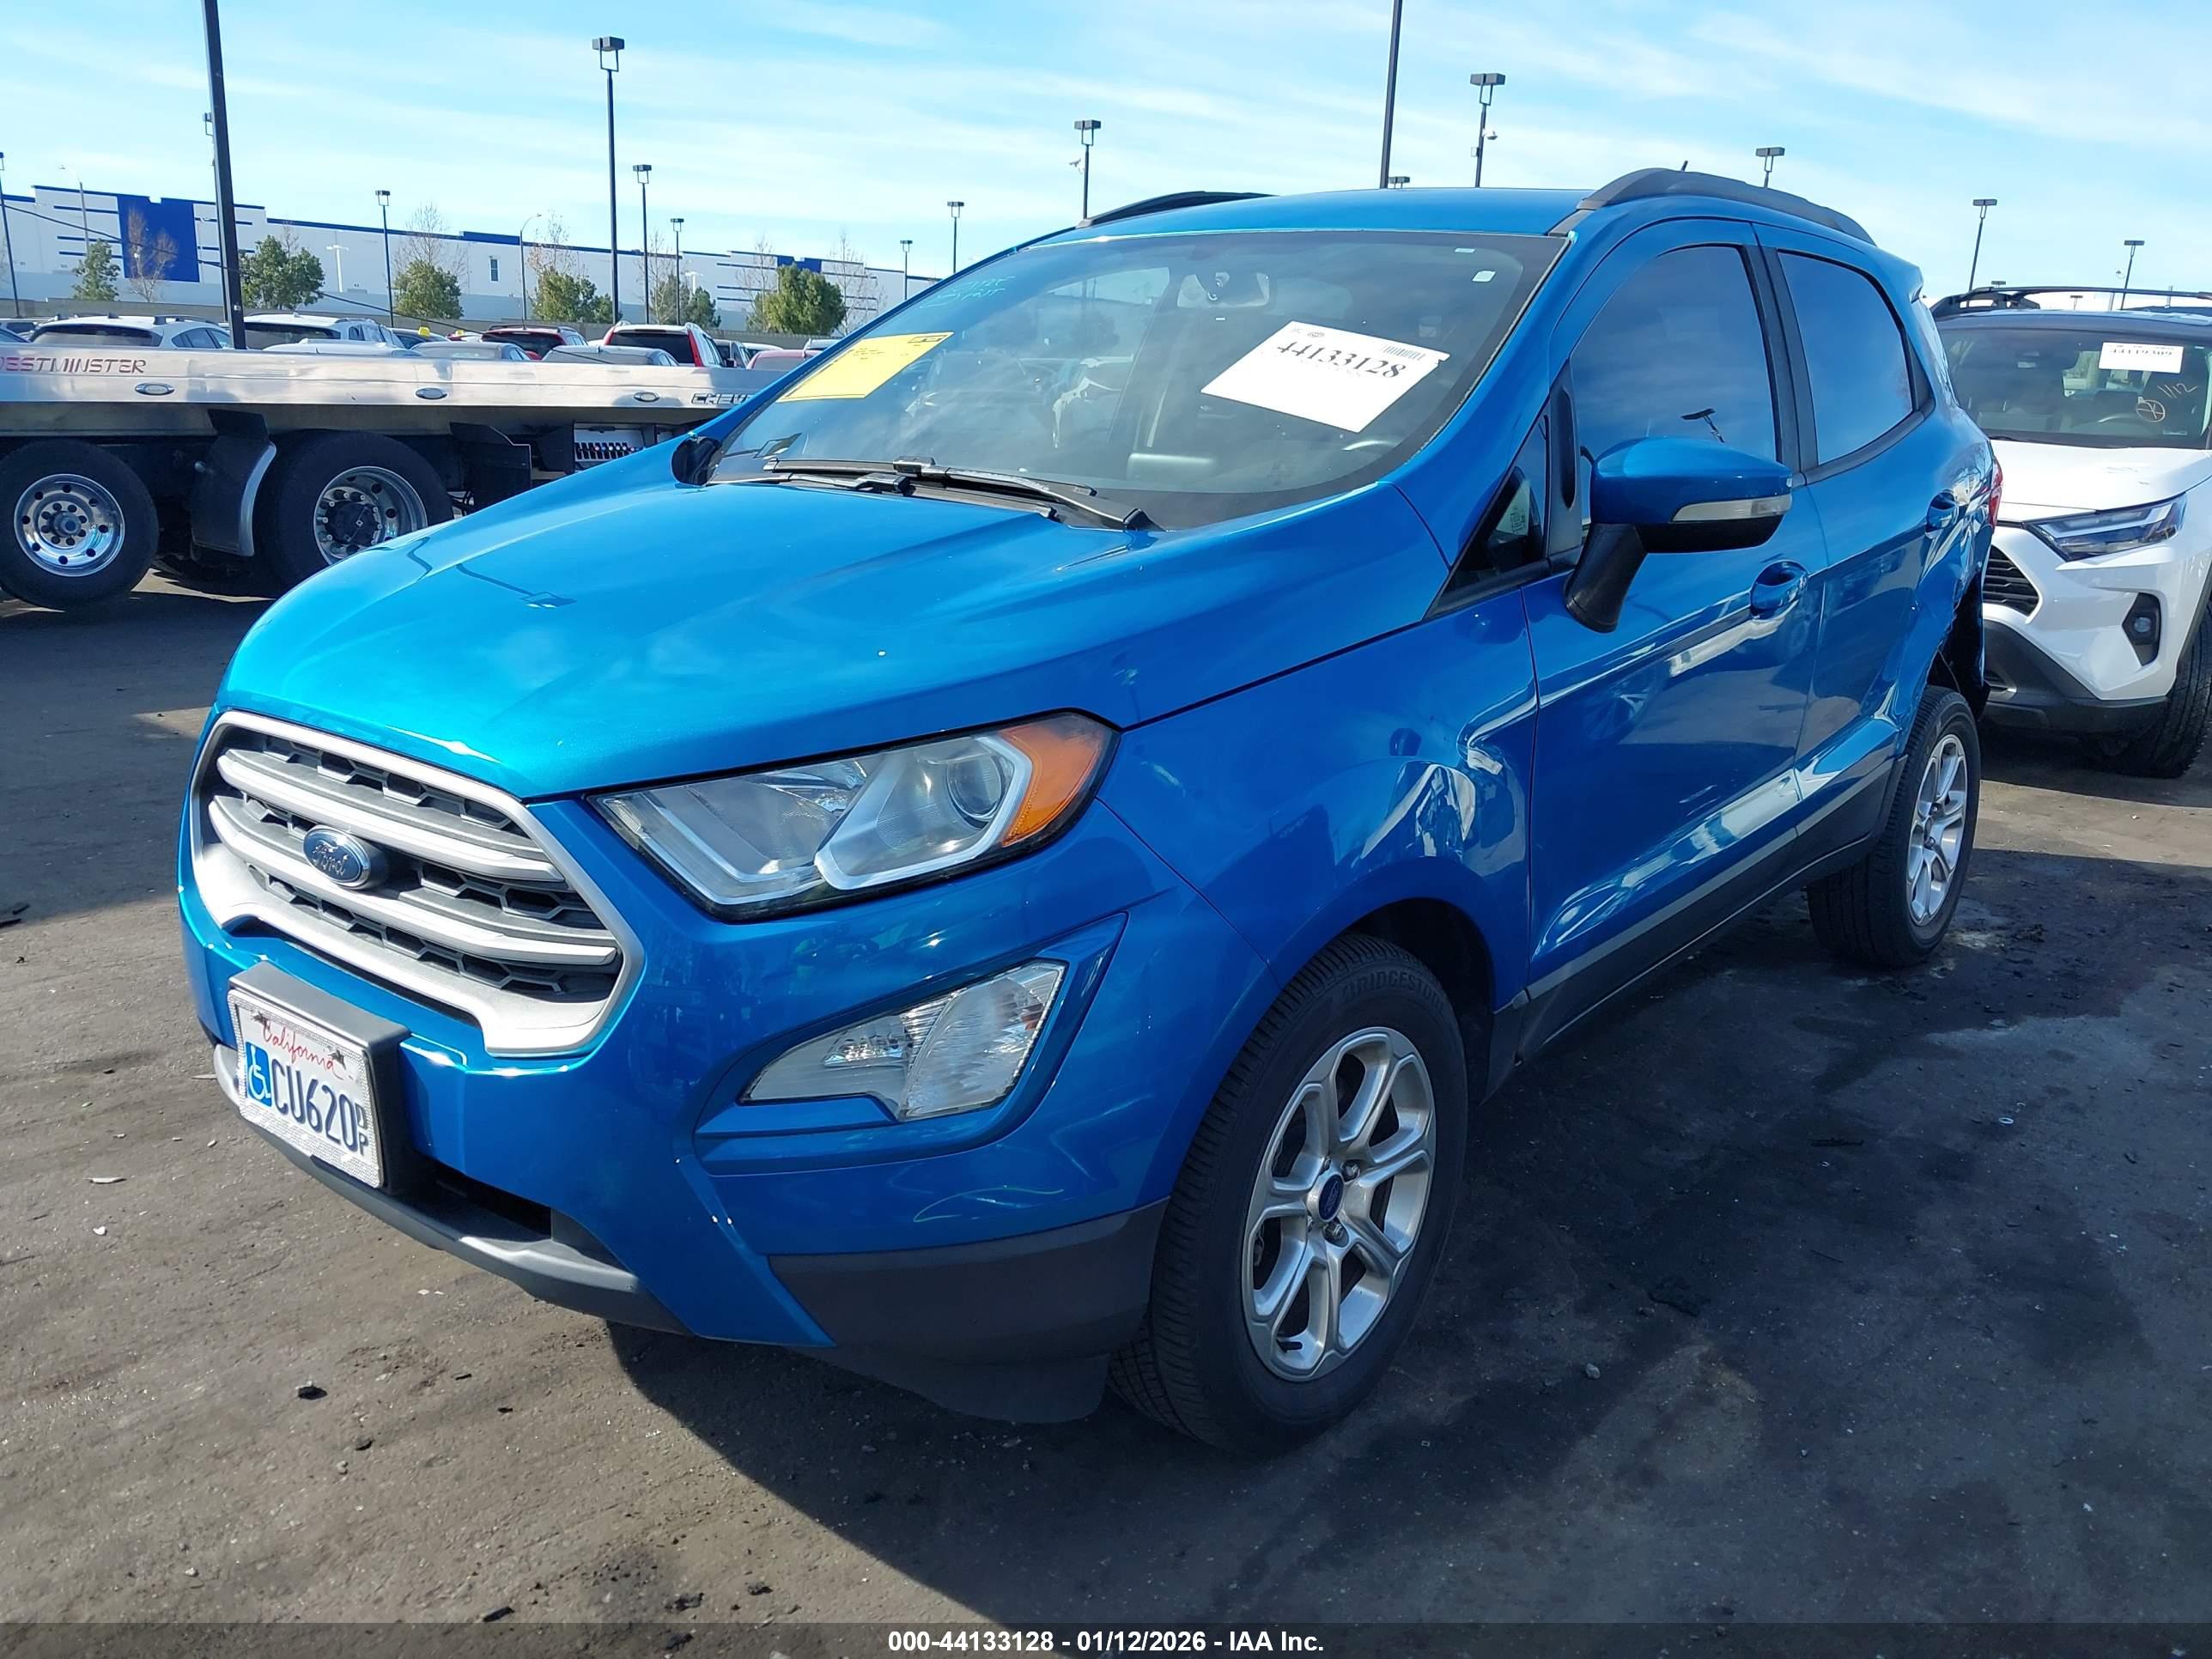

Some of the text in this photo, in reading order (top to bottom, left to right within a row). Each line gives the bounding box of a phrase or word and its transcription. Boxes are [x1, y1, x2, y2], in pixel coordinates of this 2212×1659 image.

[0, 356, 147, 374] ESTMINSTER
[1277, 342, 1407, 378] 44133128
[691, 392, 751, 405] CHEV
[312, 840, 348, 877] Ford
[262, 1021, 343, 1080] California
[271, 1058, 358, 1152] CU620
